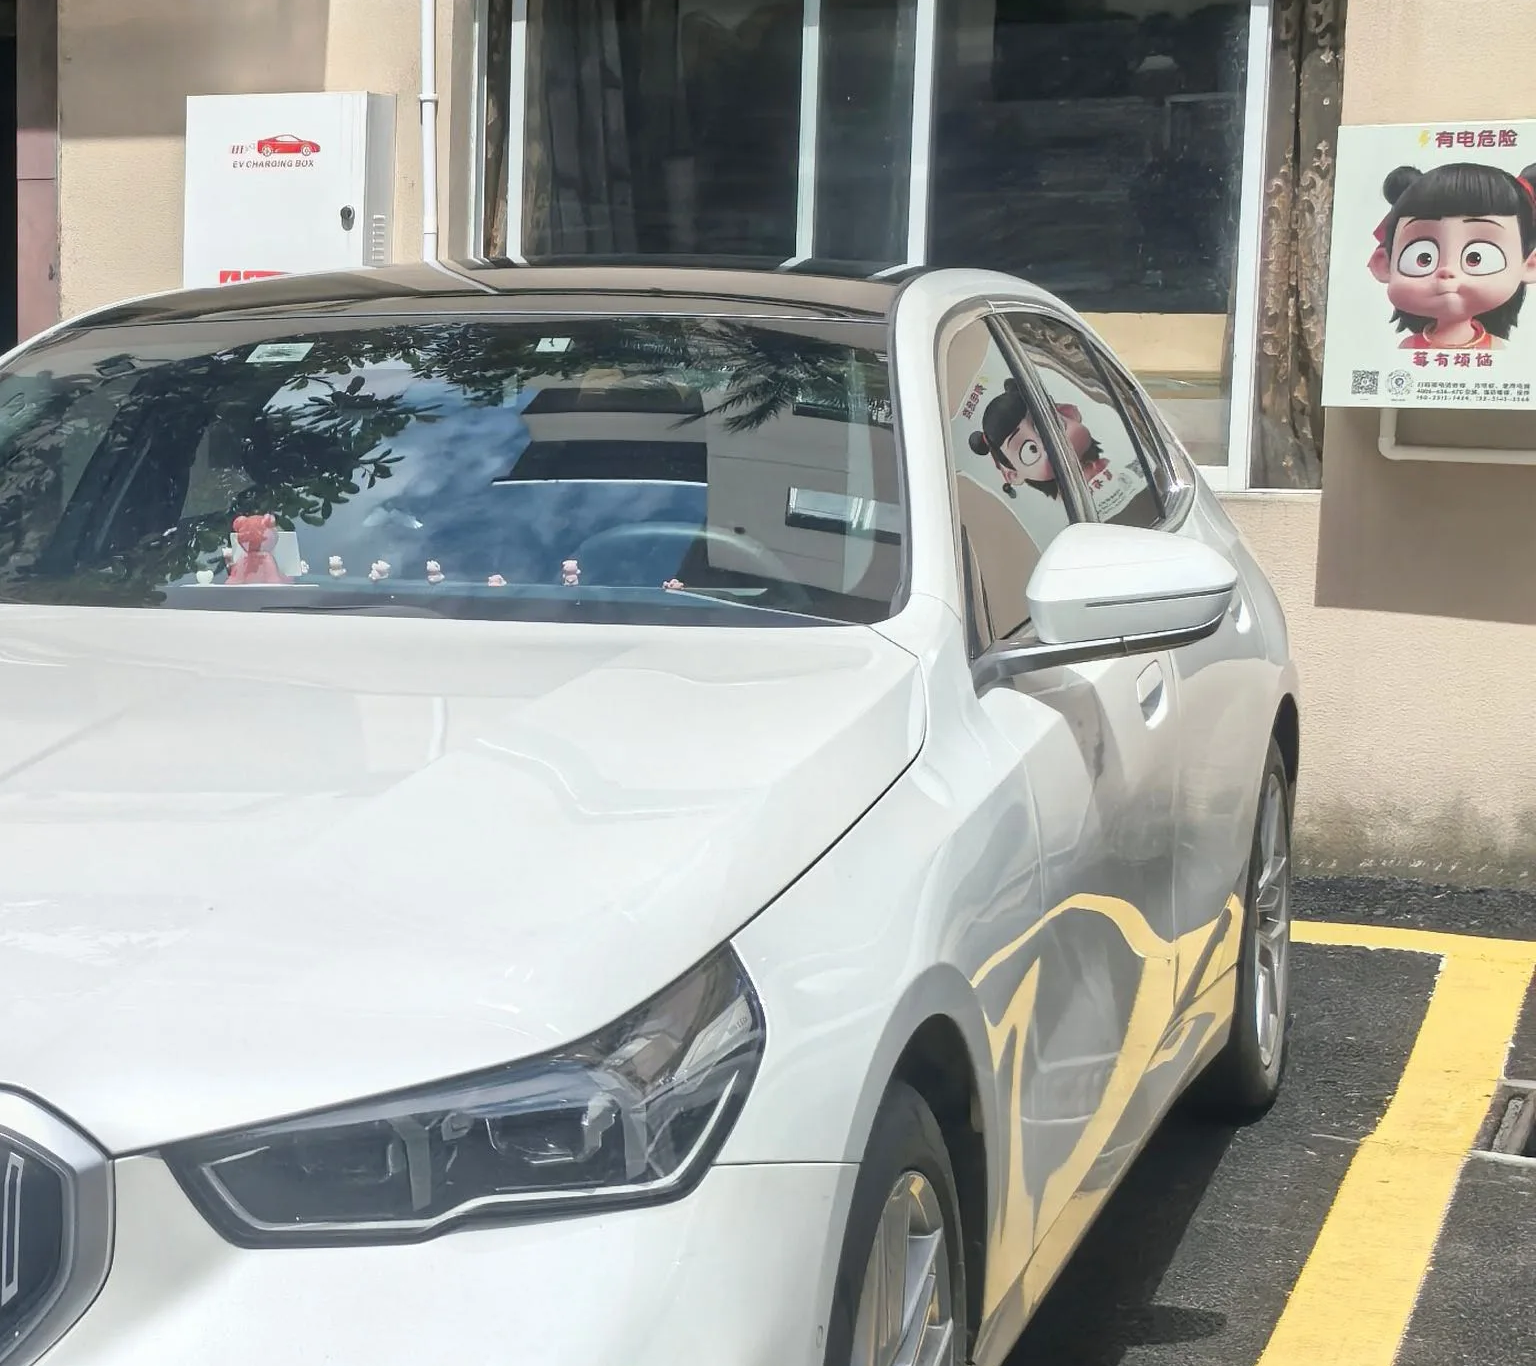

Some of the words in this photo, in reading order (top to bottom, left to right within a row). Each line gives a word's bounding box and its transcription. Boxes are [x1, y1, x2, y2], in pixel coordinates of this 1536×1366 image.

[1435, 129, 1518, 148] 有电危险
[232, 160, 244, 168] EV
[246, 160, 293, 168] CHARGING
[295, 159, 314, 168] BOX
[1413, 350, 1493, 367] 莓有烦恼
